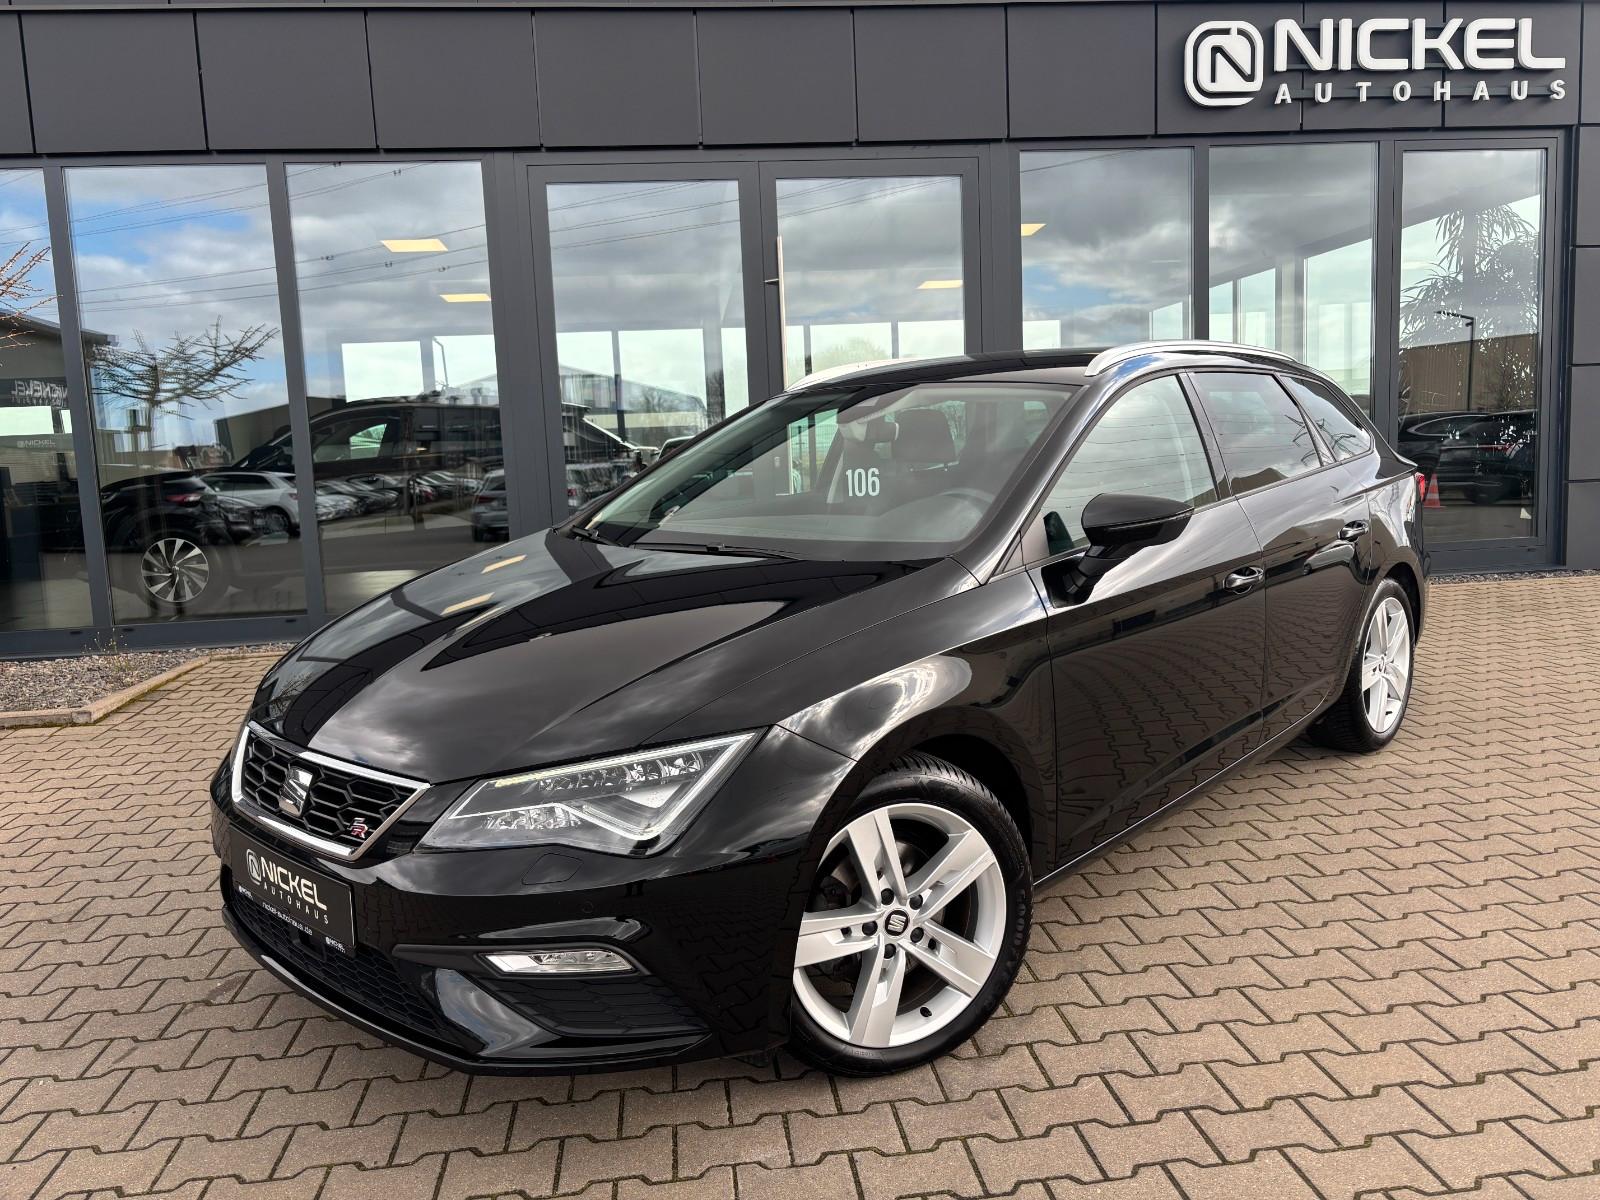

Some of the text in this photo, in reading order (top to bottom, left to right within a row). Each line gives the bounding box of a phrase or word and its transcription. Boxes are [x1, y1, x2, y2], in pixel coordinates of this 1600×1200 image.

[1274, 17, 1567, 71] NICKEL
[1274, 79, 1567, 105] AUTOHAUS
[845, 467, 880, 497] 106
[260, 856, 327, 911] NICKEL
[263, 882, 329, 925] AUTOHAUS
